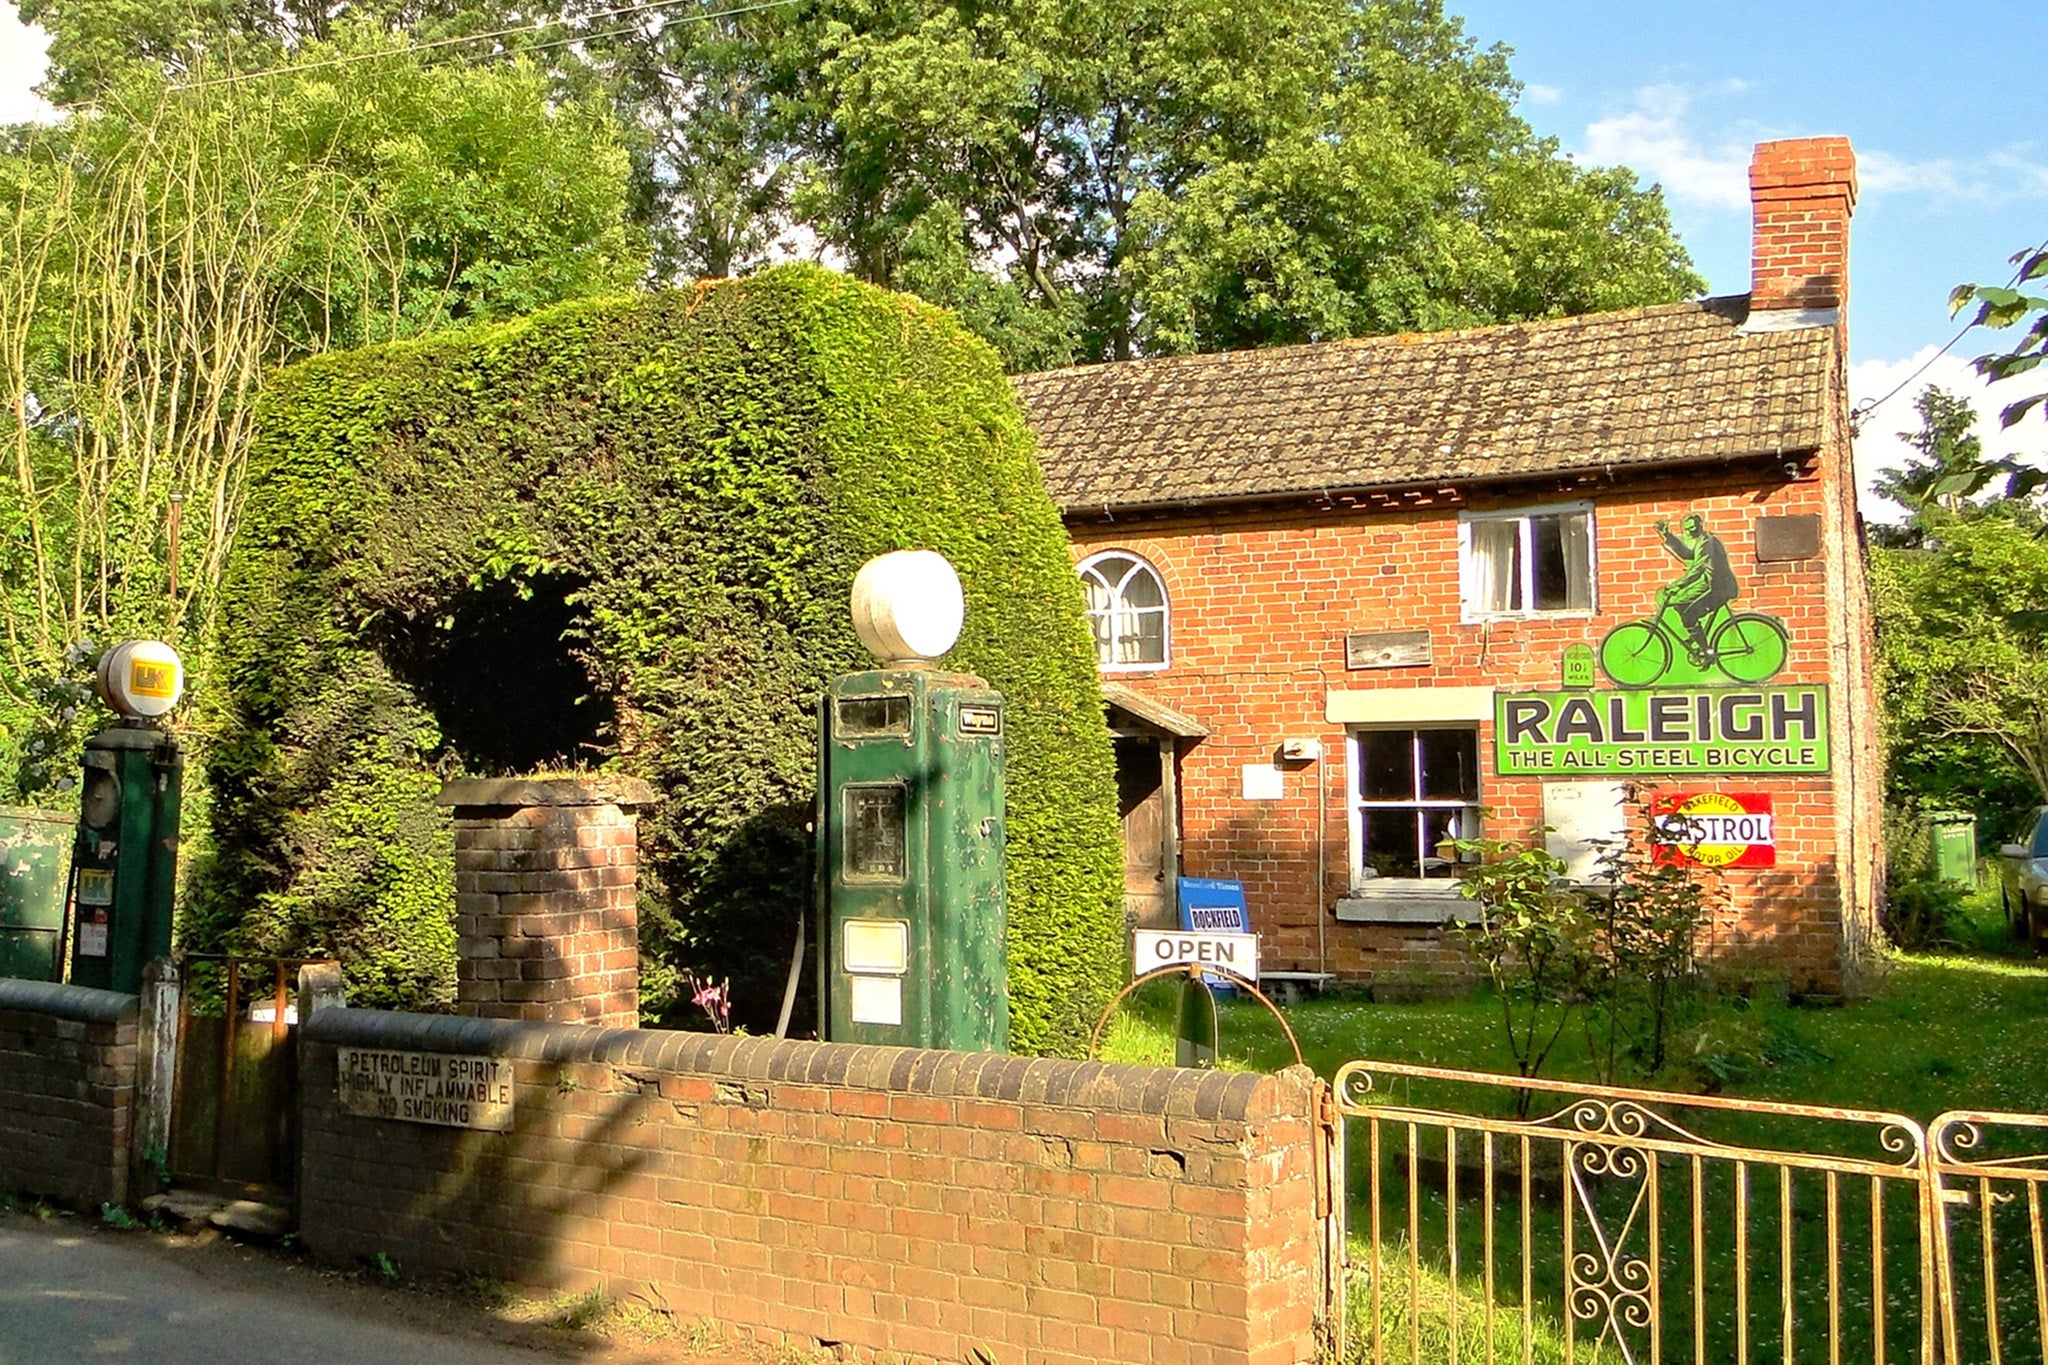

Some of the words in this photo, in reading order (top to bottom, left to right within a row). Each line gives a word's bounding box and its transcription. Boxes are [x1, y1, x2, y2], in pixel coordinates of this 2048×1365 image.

[1506, 693, 1817, 744] RALEIGH
[1508, 750, 1554, 768] THE
[1706, 747, 1816, 766] BICYCLE
[1725, 846, 1743, 861] OIL
[1192, 909, 1241, 929] ROCKFIELD
[1155, 939, 1235, 963] OPEN
[350, 1052, 442, 1078] PETROLEUM
[449, 1059, 500, 1083] SPIRIT
[340, 1071, 393, 1095] HIGHLY
[400, 1077, 509, 1105] INFLAMMABLE
[378, 1096, 398, 1116] NO
[402, 1098, 470, 1124] SMOKING
